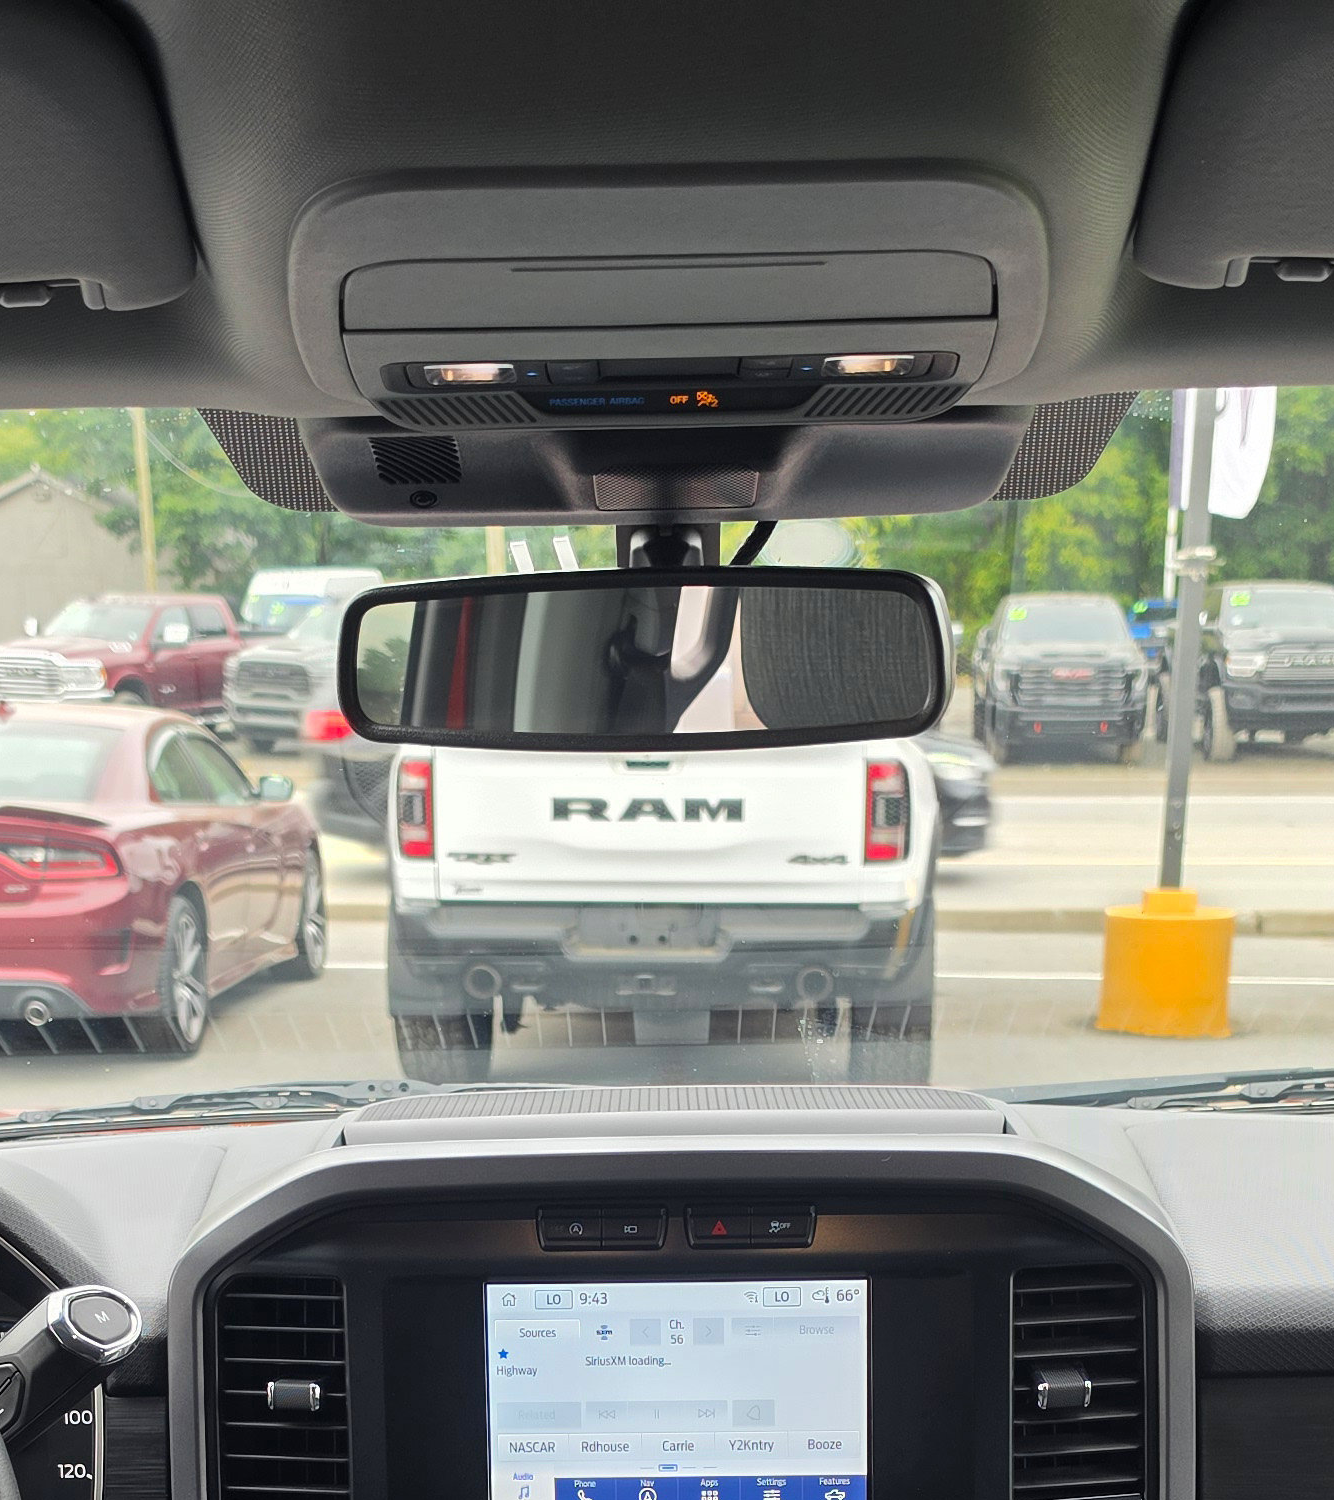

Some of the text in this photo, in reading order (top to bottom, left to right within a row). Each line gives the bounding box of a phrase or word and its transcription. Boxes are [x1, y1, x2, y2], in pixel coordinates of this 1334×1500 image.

[549, 397, 646, 406] PASSENGER AIRBAG
[670, 395, 689, 405] OFF
[551, 797, 744, 822] RAM
[546, 1293, 562, 1306] LO
[579, 1292, 608, 1306] 9:43
[774, 1291, 790, 1303] LO
[669, 1319, 685, 1330] Ch.
[519, 1327, 557, 1339] Sources
[799, 1325, 835, 1336] Browse
[670, 1334, 684, 1345] 56
[585, 1356, 626, 1367] SiriusXM
[496, 1365, 538, 1378] Highway
[64, 1410, 93, 1425] 100
[518, 1409, 556, 1420] Related
[509, 1441, 556, 1453] NASCAR
[580, 1440, 630, 1453] Rdhouse
[662, 1440, 695, 1452] Carrie
[729, 1439, 775, 1453] Y2Kntry
[807, 1438, 843, 1450] Booze
[57, 1463, 86, 1479] 120
[513, 1472, 534, 1482] Audio
[756, 1477, 787, 1488] Settings
[819, 1476, 851, 1486] Features
[574, 1480, 597, 1489] Phone
[640, 1479, 655, 1488] Nav
[700, 1478, 719, 1488] Apps
